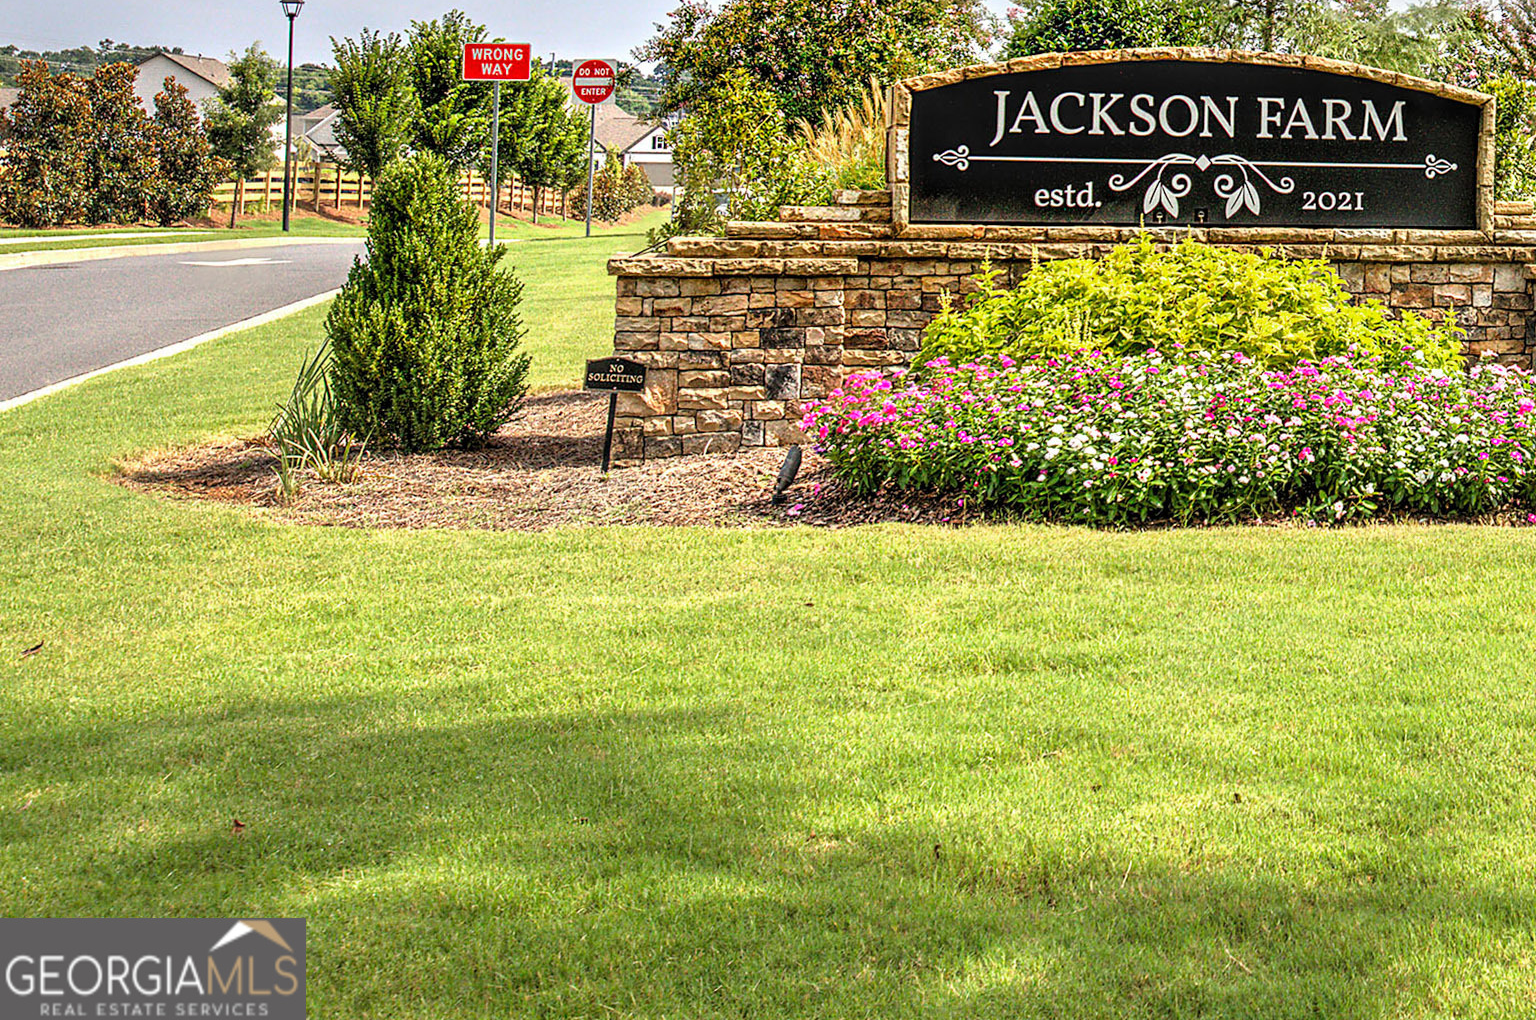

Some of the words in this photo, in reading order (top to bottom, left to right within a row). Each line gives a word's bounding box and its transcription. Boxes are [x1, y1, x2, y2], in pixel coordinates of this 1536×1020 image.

[472, 48, 523, 61] WRONG
[481, 63, 513, 76] WAY
[579, 67, 591, 76] DO
[594, 67, 610, 76] NOT
[581, 87, 606, 96] ENTER
[989, 89, 1239, 148] JACKSON
[1256, 96, 1408, 142] FARM
[1033, 180, 1102, 208] estd.
[1302, 191, 1365, 212] 2021
[609, 364, 625, 373] NO
[588, 372, 643, 384] SOLICITING
